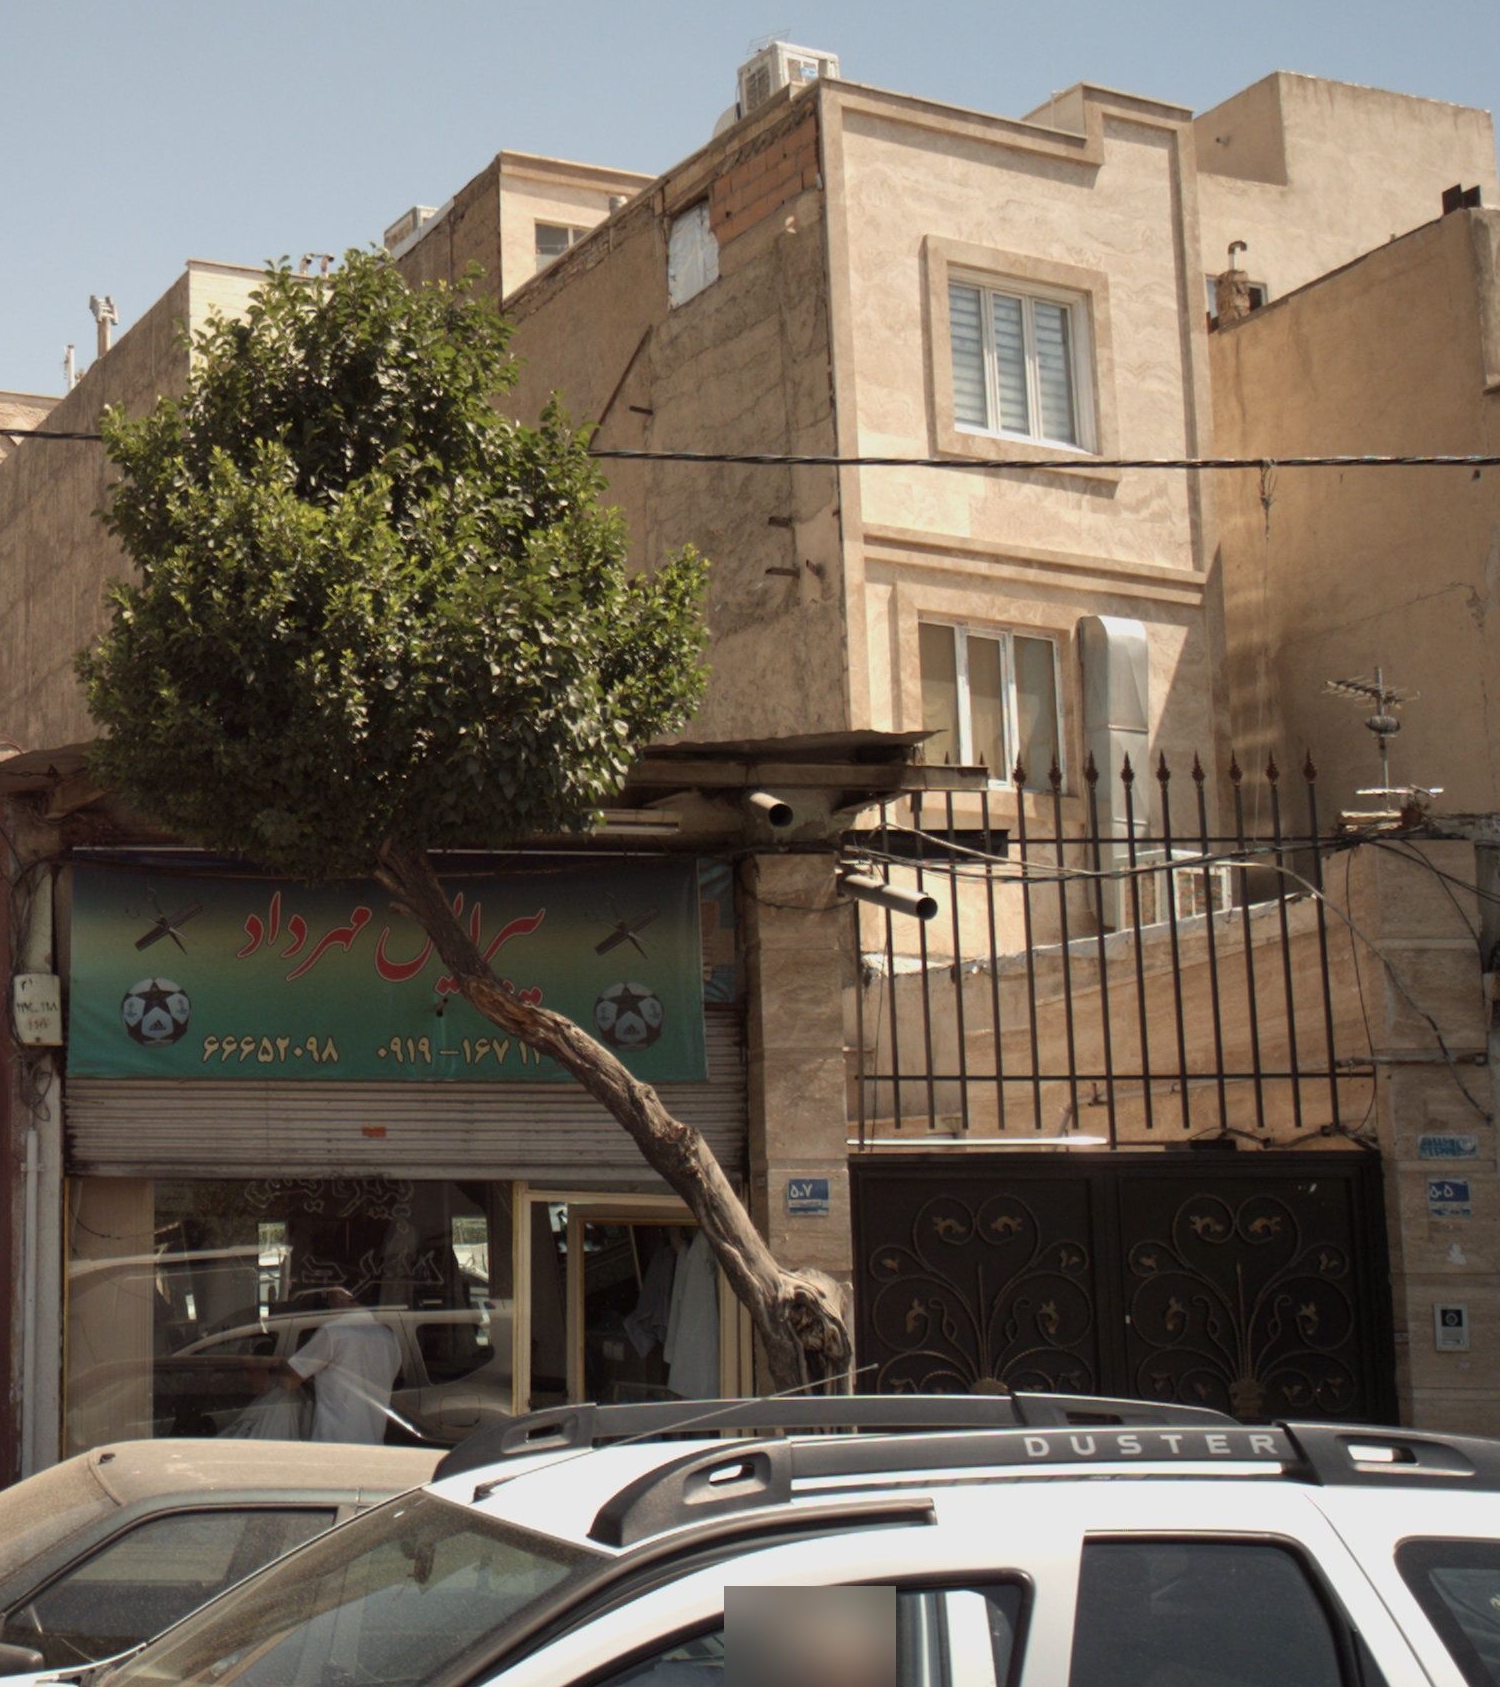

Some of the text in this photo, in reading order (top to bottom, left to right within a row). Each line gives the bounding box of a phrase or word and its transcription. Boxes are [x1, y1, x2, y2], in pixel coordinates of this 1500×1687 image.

[236, 889, 373, 982] مهرداد
[202, 1035, 339, 1063] ۶۶۶۵۲۰۹۸
[790, 1183, 813, 1198] ۵۰۷
[1429, 1184, 1453, 1198] ۵۰۵
[1023, 1434, 1278, 1457] DUSTER
